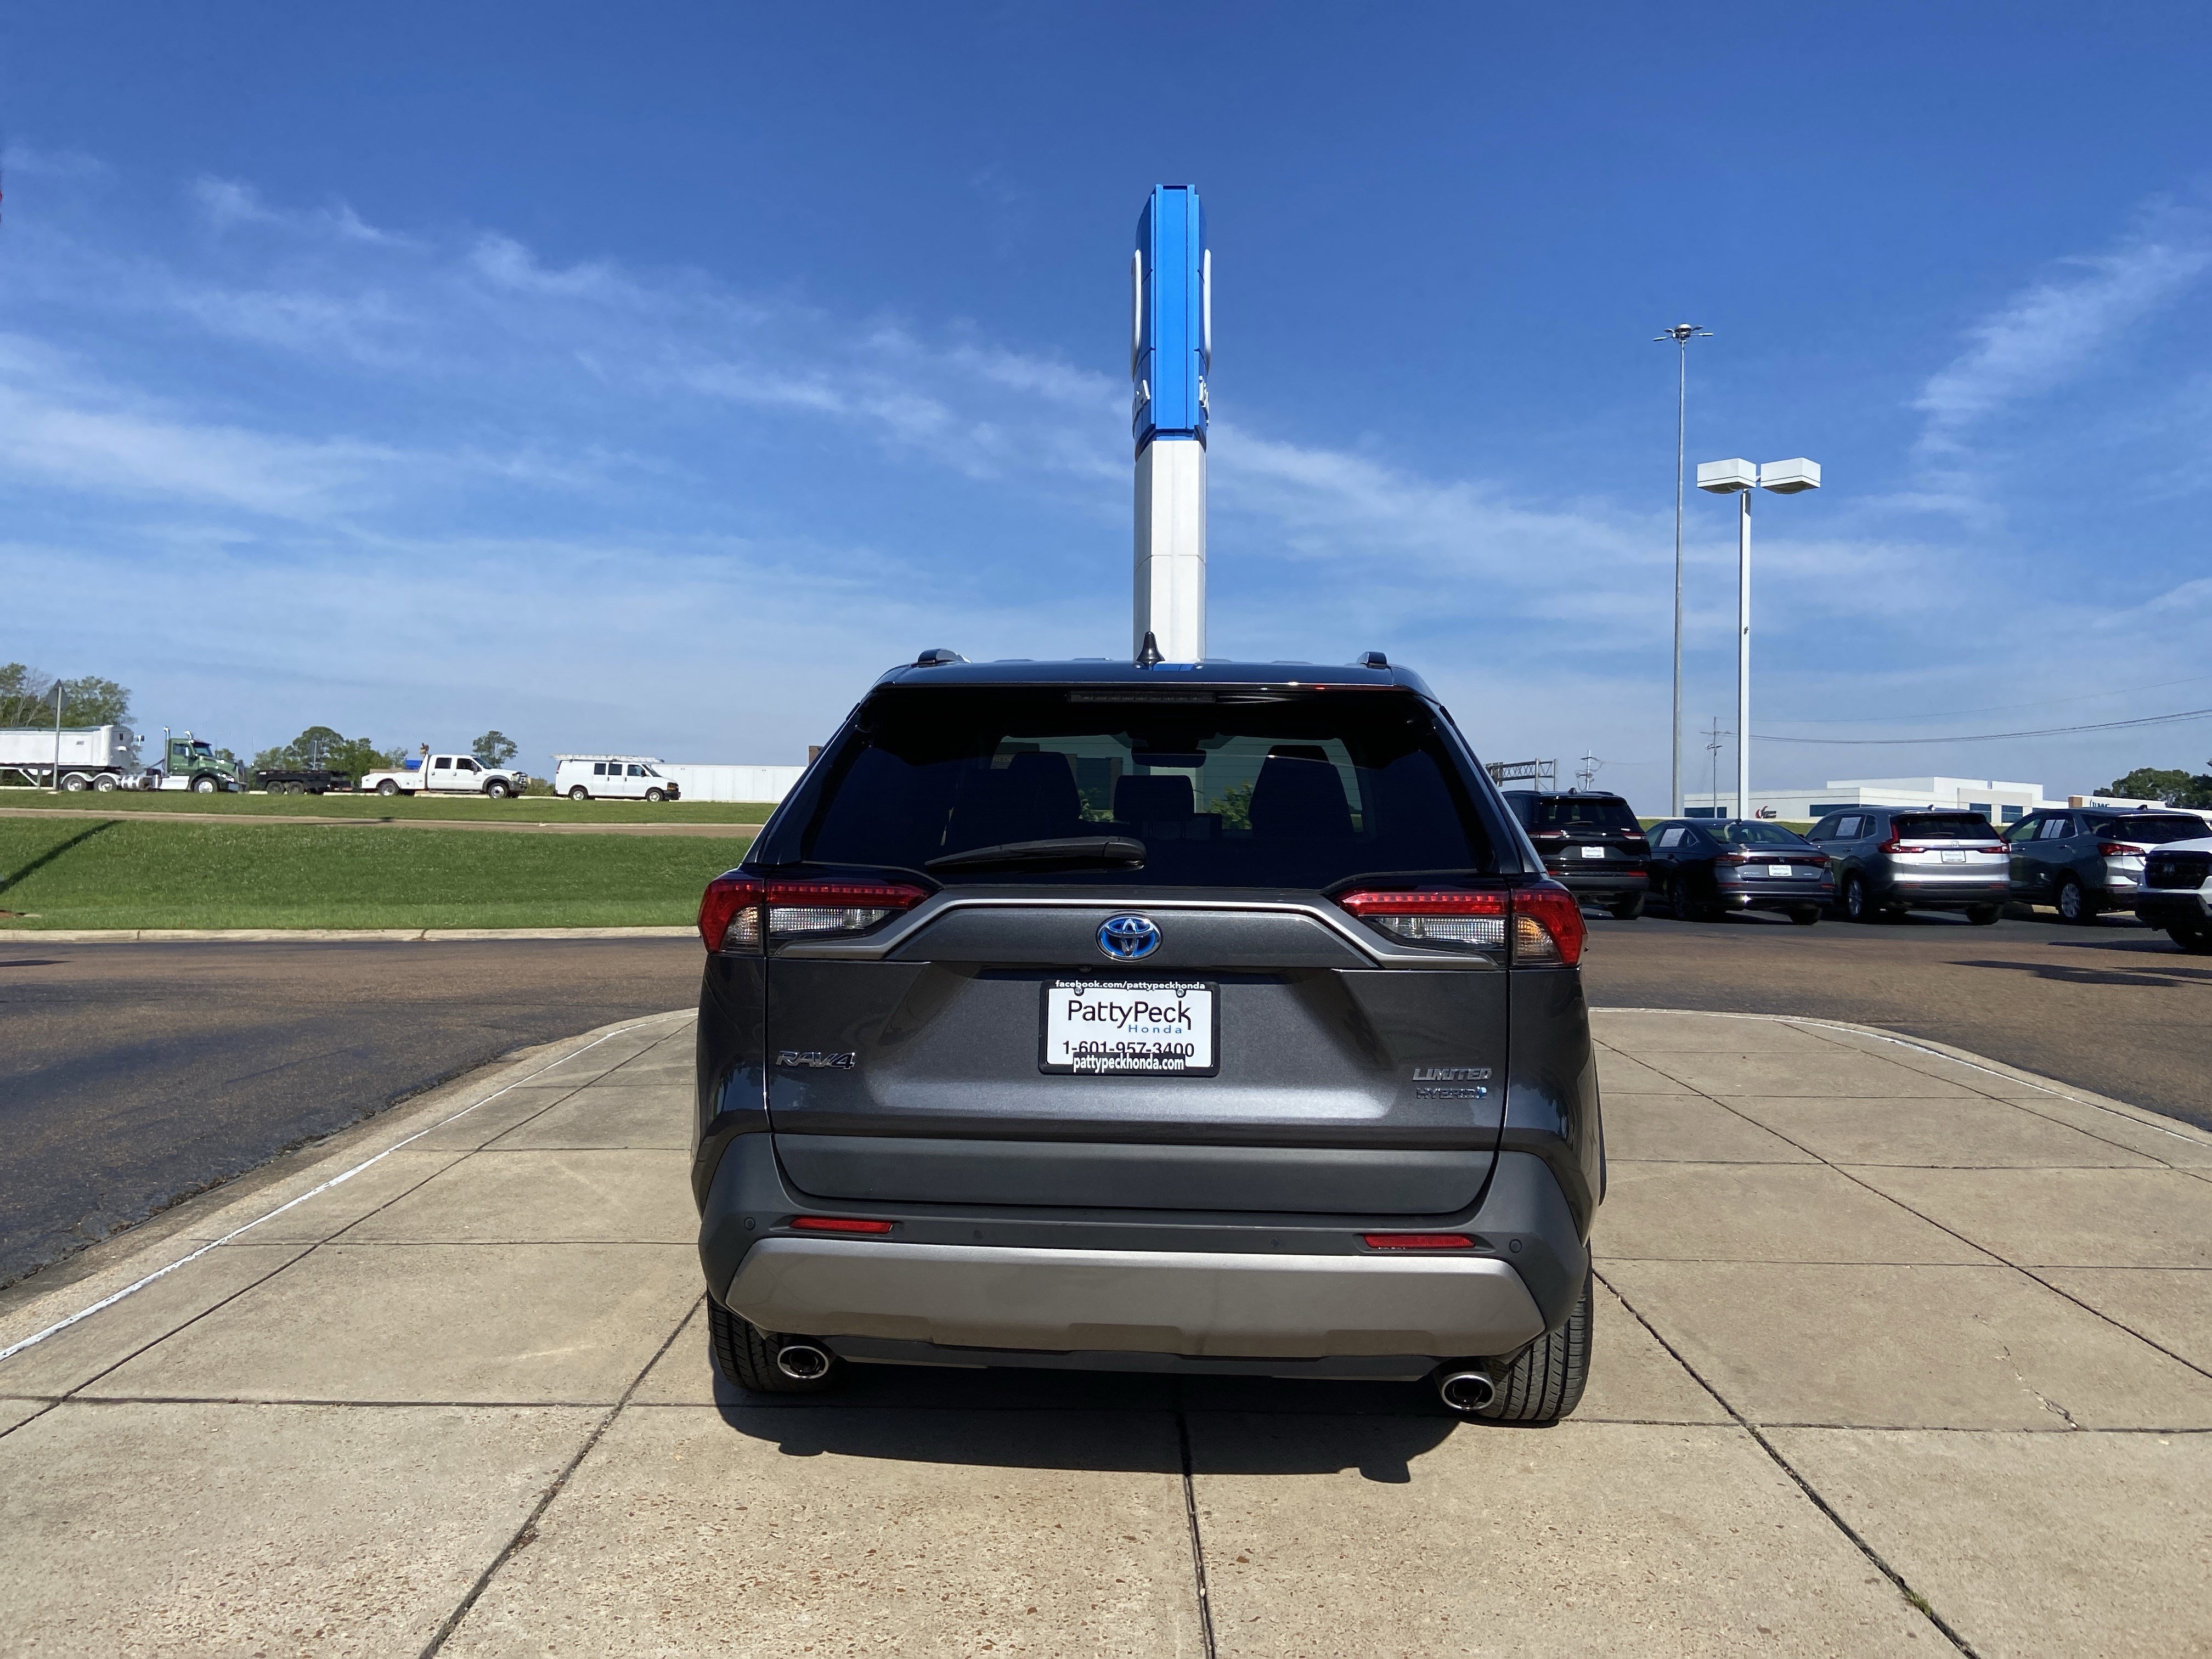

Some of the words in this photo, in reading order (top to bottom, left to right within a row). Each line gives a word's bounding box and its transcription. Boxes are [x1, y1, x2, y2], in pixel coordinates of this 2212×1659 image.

[1055, 980, 1205, 991] facebook.com/pattypeckhonda
[1068, 1000, 1191, 1030] PattyPeck
[1128, 1024, 1182, 1034] Honda
[1063, 1040, 1194, 1057] 1-601-957-3400
[776, 1050, 855, 1070] RAV4
[1073, 1053, 1184, 1073] pattypeckhonda.com
[1412, 1067, 1492, 1081] LIMITED
